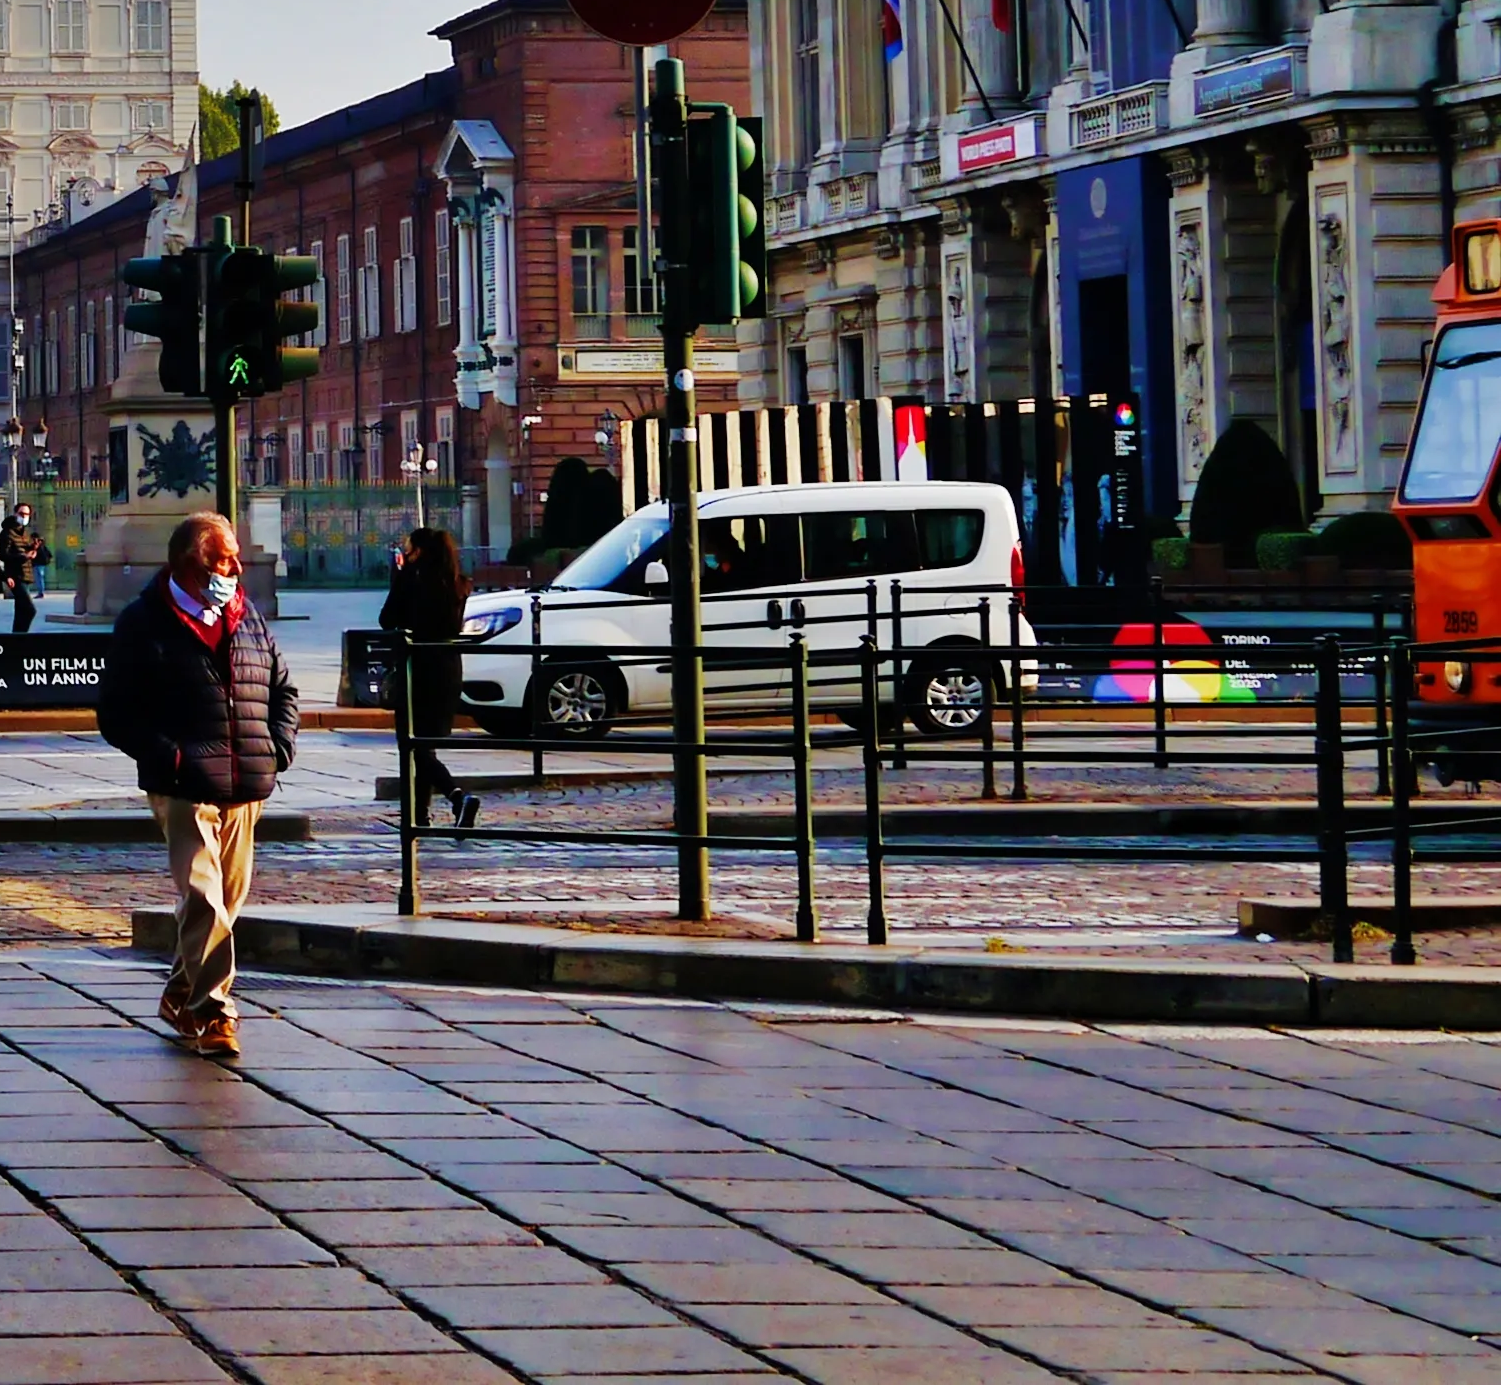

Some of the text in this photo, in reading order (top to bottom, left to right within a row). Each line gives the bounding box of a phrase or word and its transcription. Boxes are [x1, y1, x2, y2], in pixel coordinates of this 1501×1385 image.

[1222, 635, 1270, 645] TORINO
[23, 658, 47, 671] UN
[51, 658, 88, 670] FILM
[24, 672, 99, 686] UN ANNO
